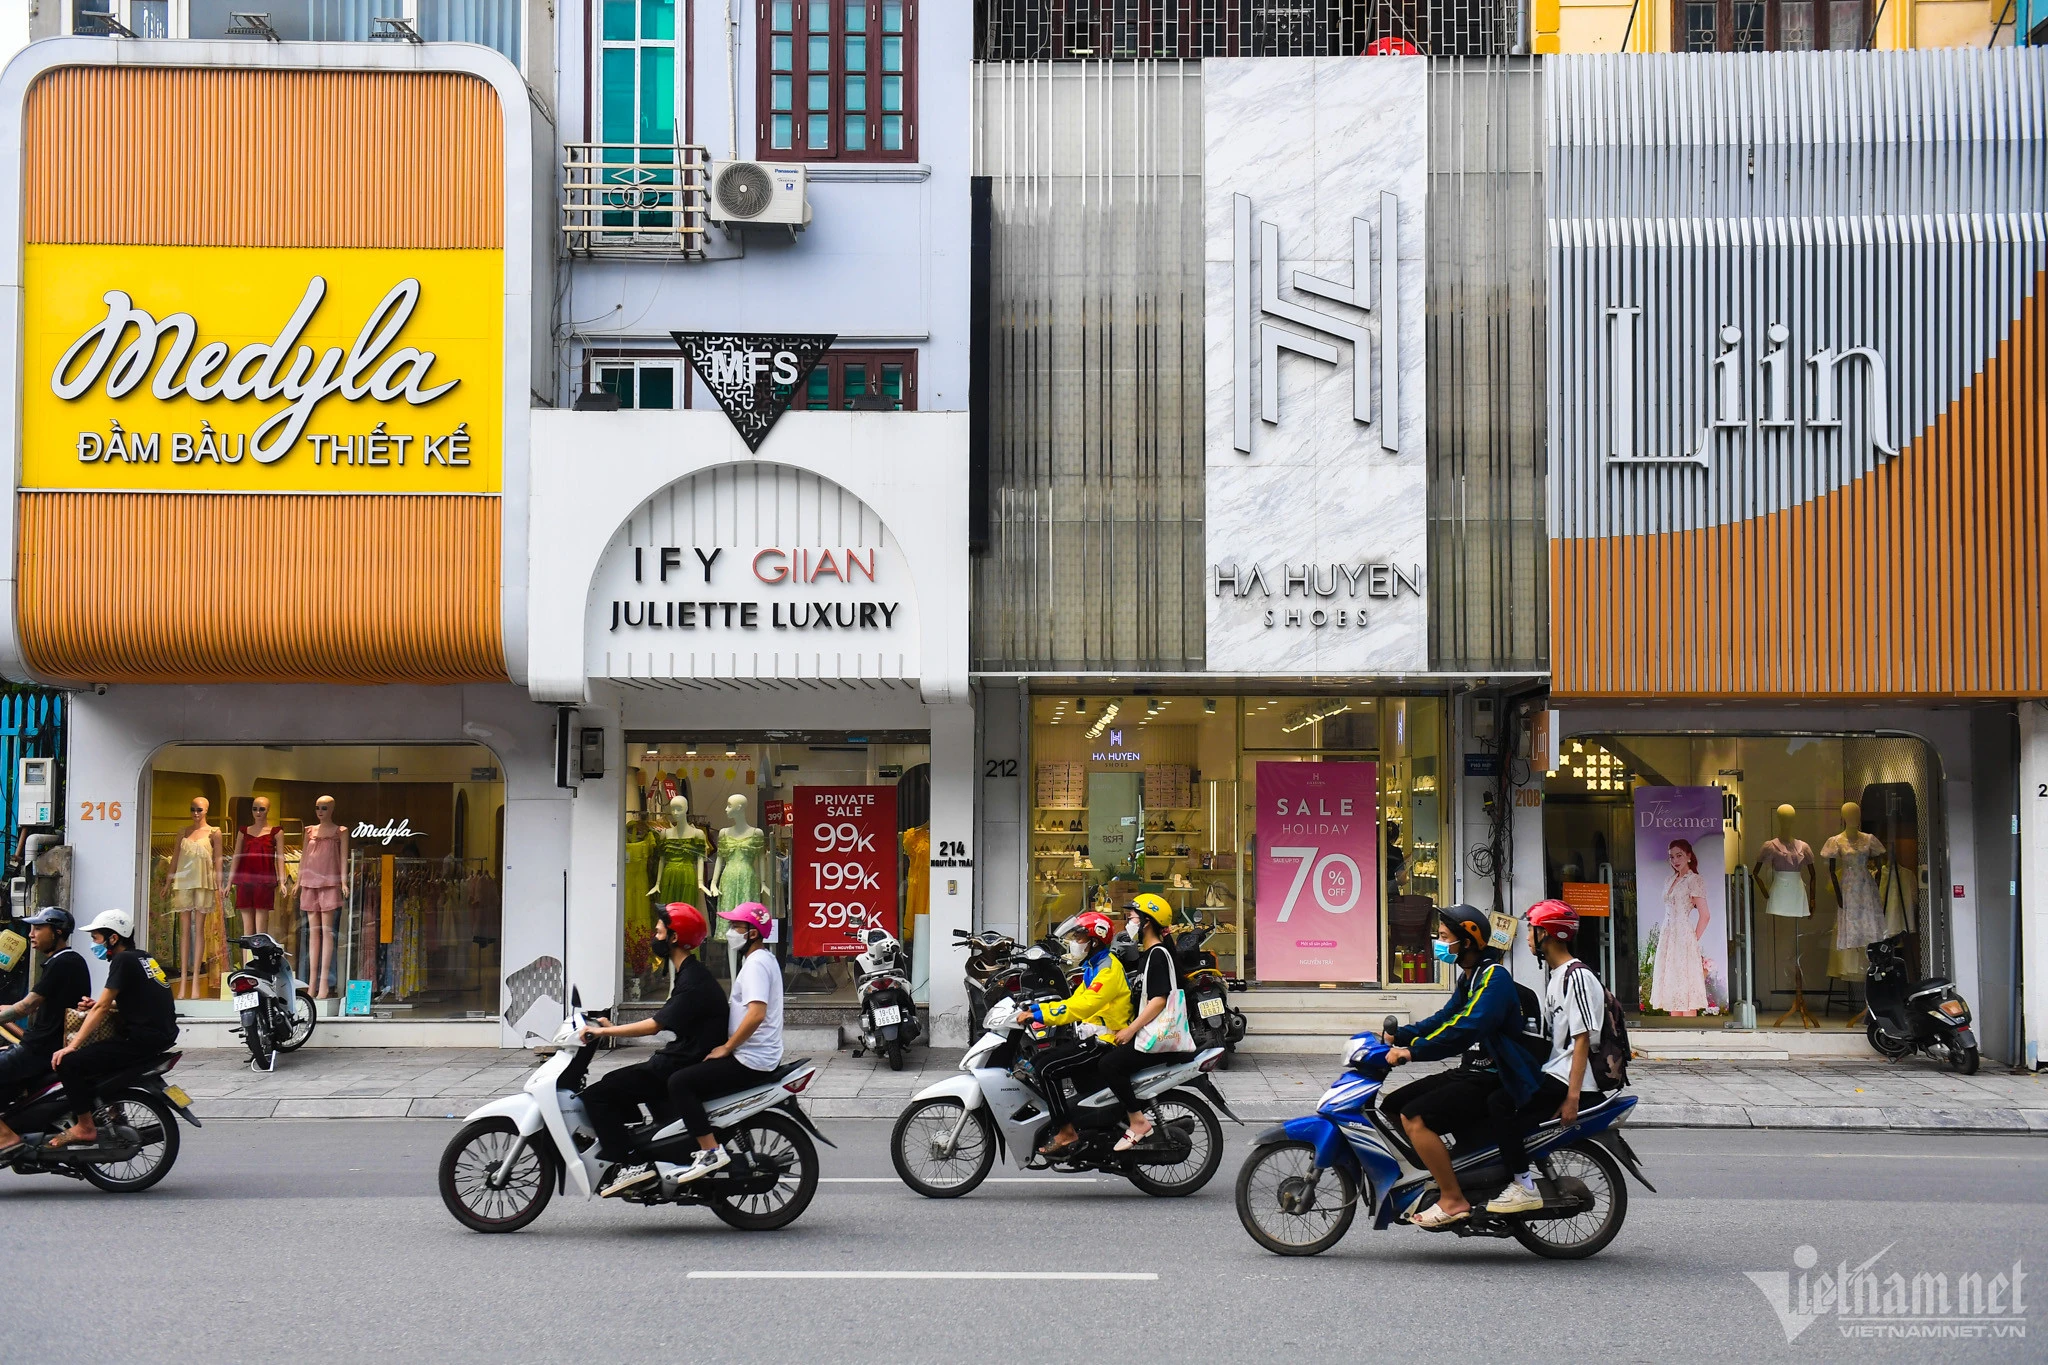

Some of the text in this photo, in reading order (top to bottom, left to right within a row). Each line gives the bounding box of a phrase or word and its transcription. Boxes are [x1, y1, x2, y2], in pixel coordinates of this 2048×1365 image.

[51, 275, 462, 464] Medyla
[711, 350, 799, 385] MFS
[1605, 305, 1900, 468] Liin
[76, 419, 471, 466] ĐẦM BẦU THIẾT KẾ
[1214, 562, 1421, 597] HA HUYEN
[609, 600, 899, 631] JULIETTE LUXURY
[1264, 608, 1368, 627] SHOES
[1108, 752, 1140, 761] HUYEN
[985, 760, 1018, 777] 212
[815, 794, 875, 805] PRIVATE
[1515, 788, 1540, 807] 210B
[80, 801, 122, 821] 216
[827, 806, 863, 817] SALE
[1276, 798, 1354, 816] SALE
[1649, 800, 1671, 815] The
[1640, 811, 1718, 828] Dreamer
[350, 818, 430, 846] Medyla
[1282, 823, 1350, 835] HOLIDAY
[939, 841, 965, 856] 214
[1270, 846, 1362, 923] 70
[1328, 870, 1345, 886] %
[1327, 888, 1346, 897] OFF
